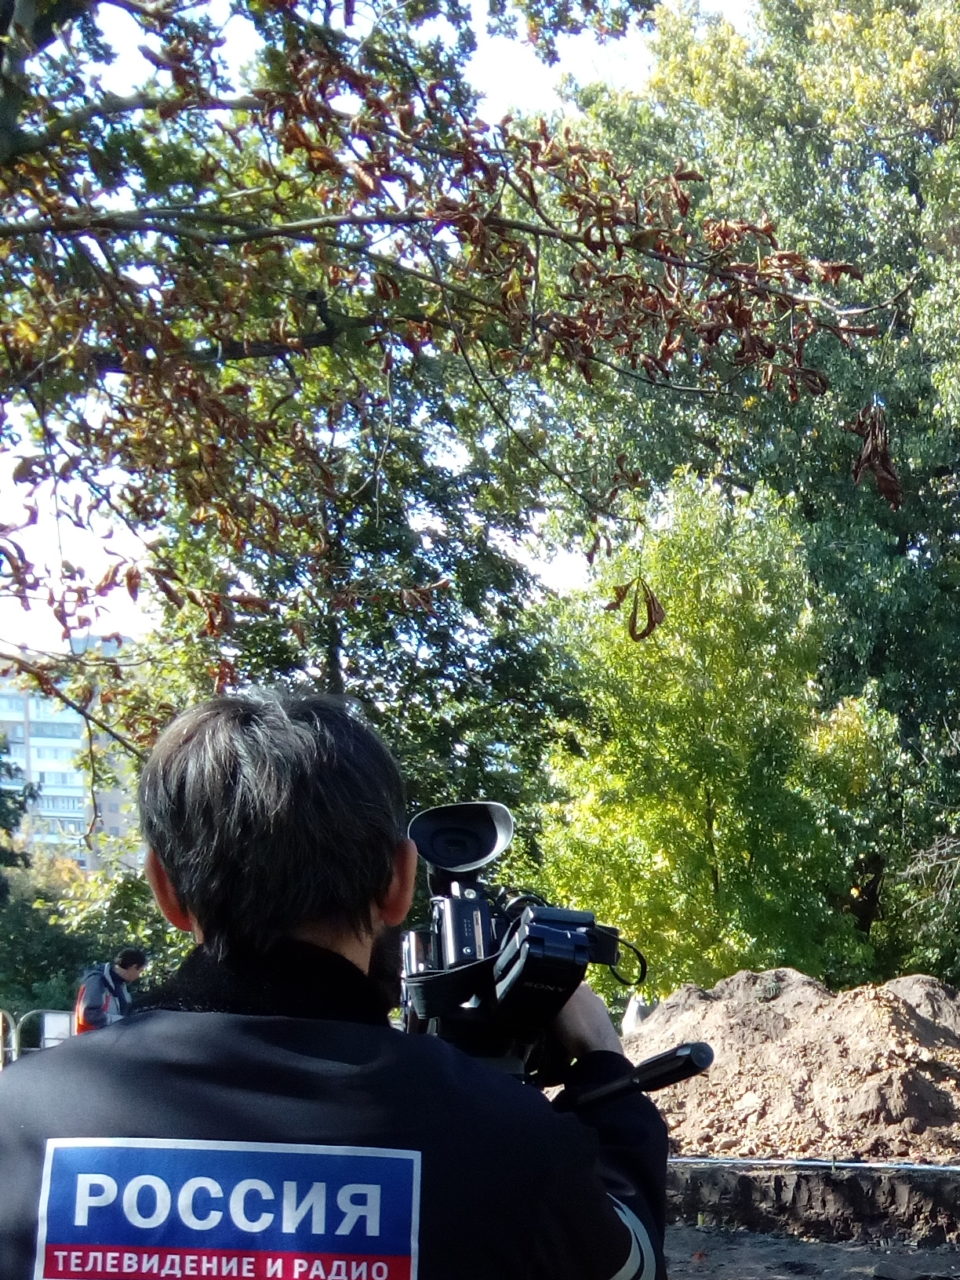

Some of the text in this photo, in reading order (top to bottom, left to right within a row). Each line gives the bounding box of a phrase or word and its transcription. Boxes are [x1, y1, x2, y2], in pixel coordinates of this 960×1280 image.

[523, 981, 567, 993] SONY
[74, 1174, 381, 1236] РОССИЯ
[54, 1251, 256, 1278] ТЕЛЕВИДЕНИЕ
[266, 1258, 283, 1278] И
